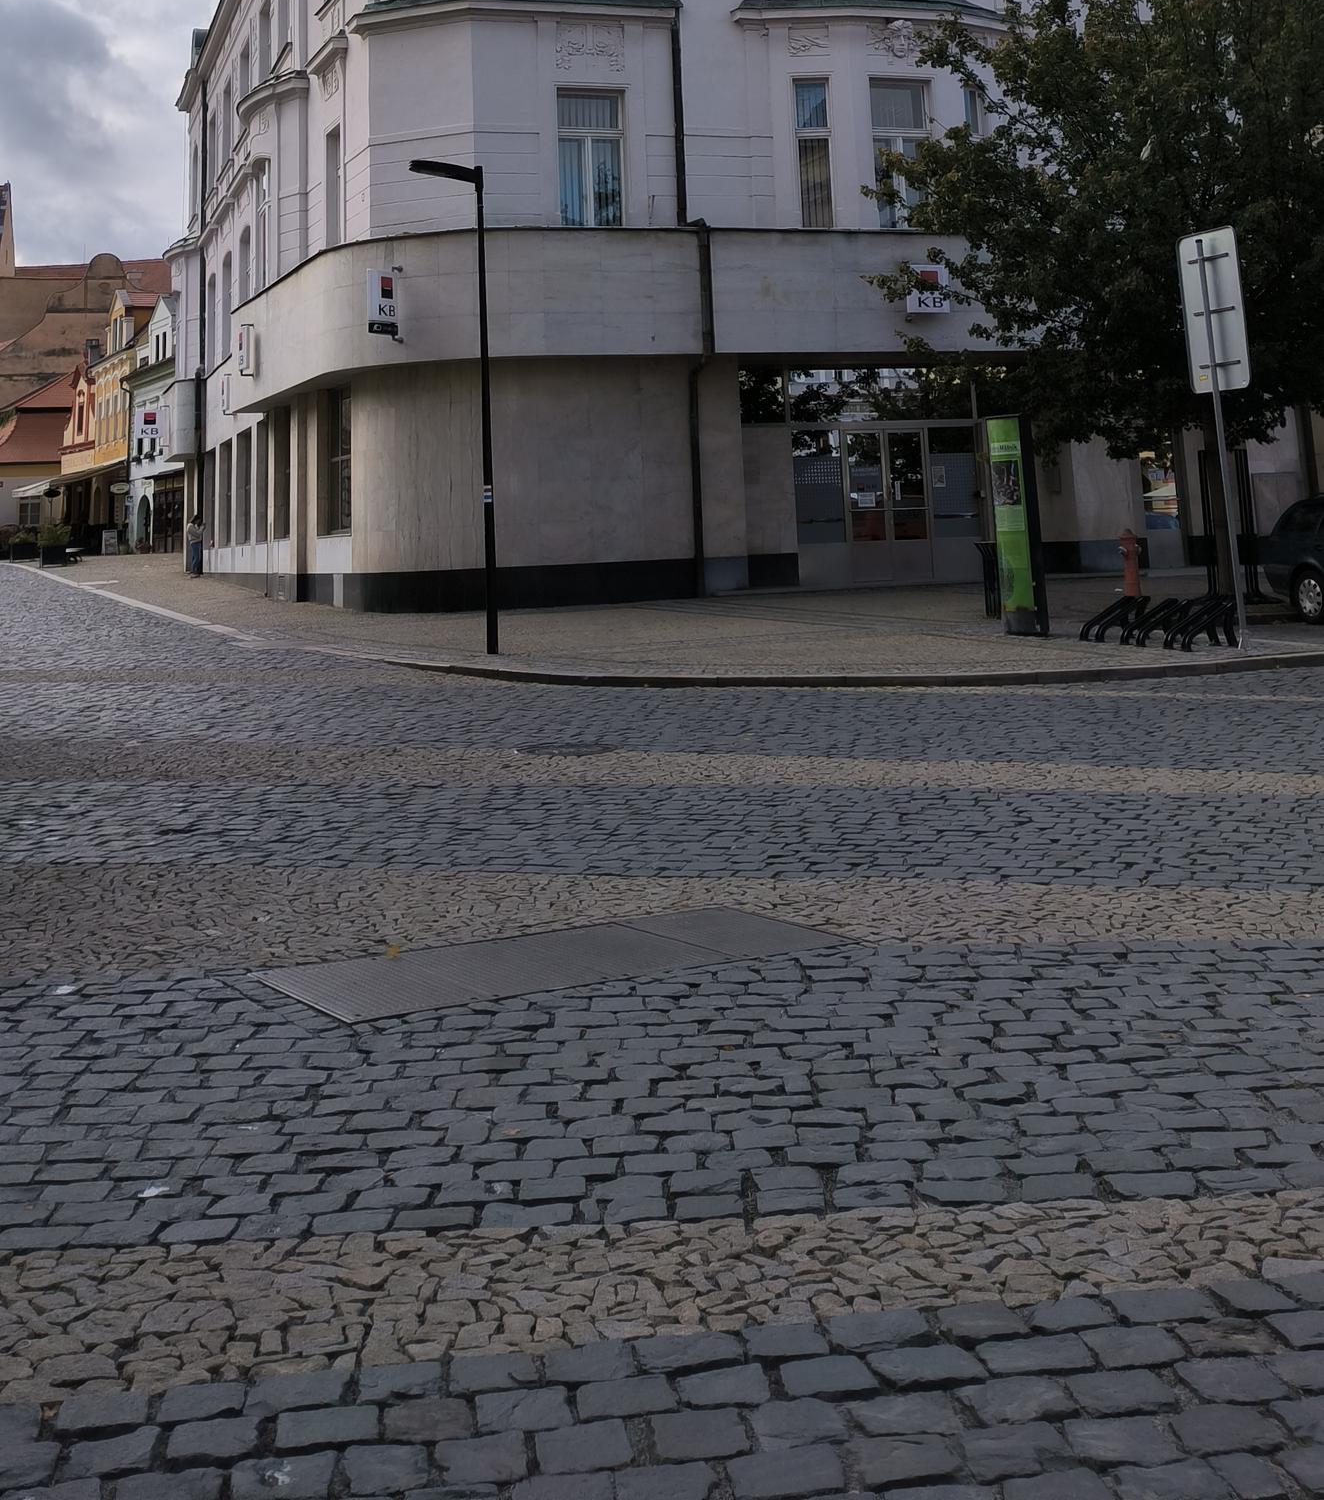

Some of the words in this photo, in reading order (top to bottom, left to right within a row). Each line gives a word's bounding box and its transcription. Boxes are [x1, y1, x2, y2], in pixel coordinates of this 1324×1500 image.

[918, 296, 943, 308] KB
[378, 303, 395, 317] KB
[141, 427, 158, 435] KB
